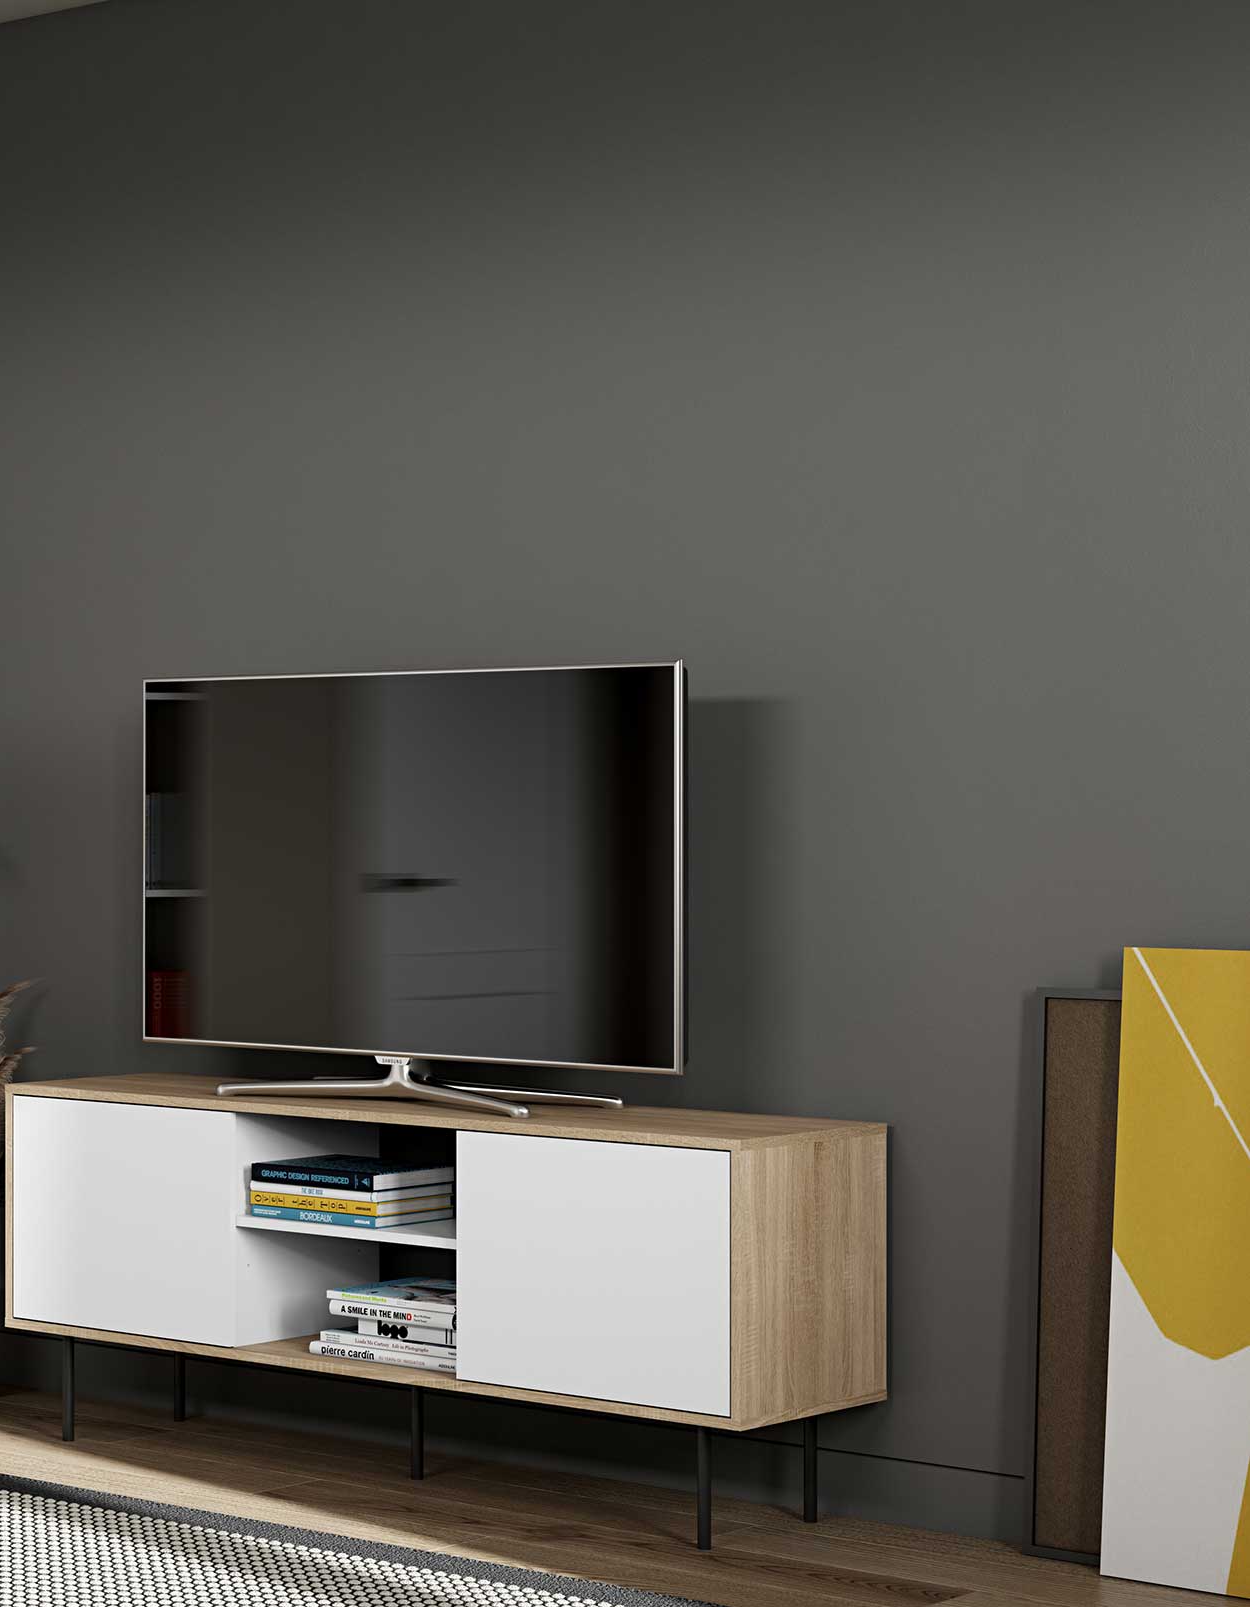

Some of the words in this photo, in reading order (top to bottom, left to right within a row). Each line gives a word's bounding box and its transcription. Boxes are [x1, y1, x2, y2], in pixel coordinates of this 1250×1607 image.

[261, 1169, 287, 1179] GRAPHIC
[288, 1173, 309, 1181] DESIGN
[310, 1174, 350, 1185] REFERENCED
[300, 1212, 332, 1223] BORDEAUX
[341, 1305, 346, 1313] A
[348, 1306, 368, 1316] SMILE
[370, 1309, 377, 1317] IN
[379, 1310, 392, 1318] THE
[393, 1312, 412, 1321] MIND
[377, 1320, 408, 1339] logo
[321, 1345, 345, 1357] pierre
[347, 1349, 375, 1360] cardin
